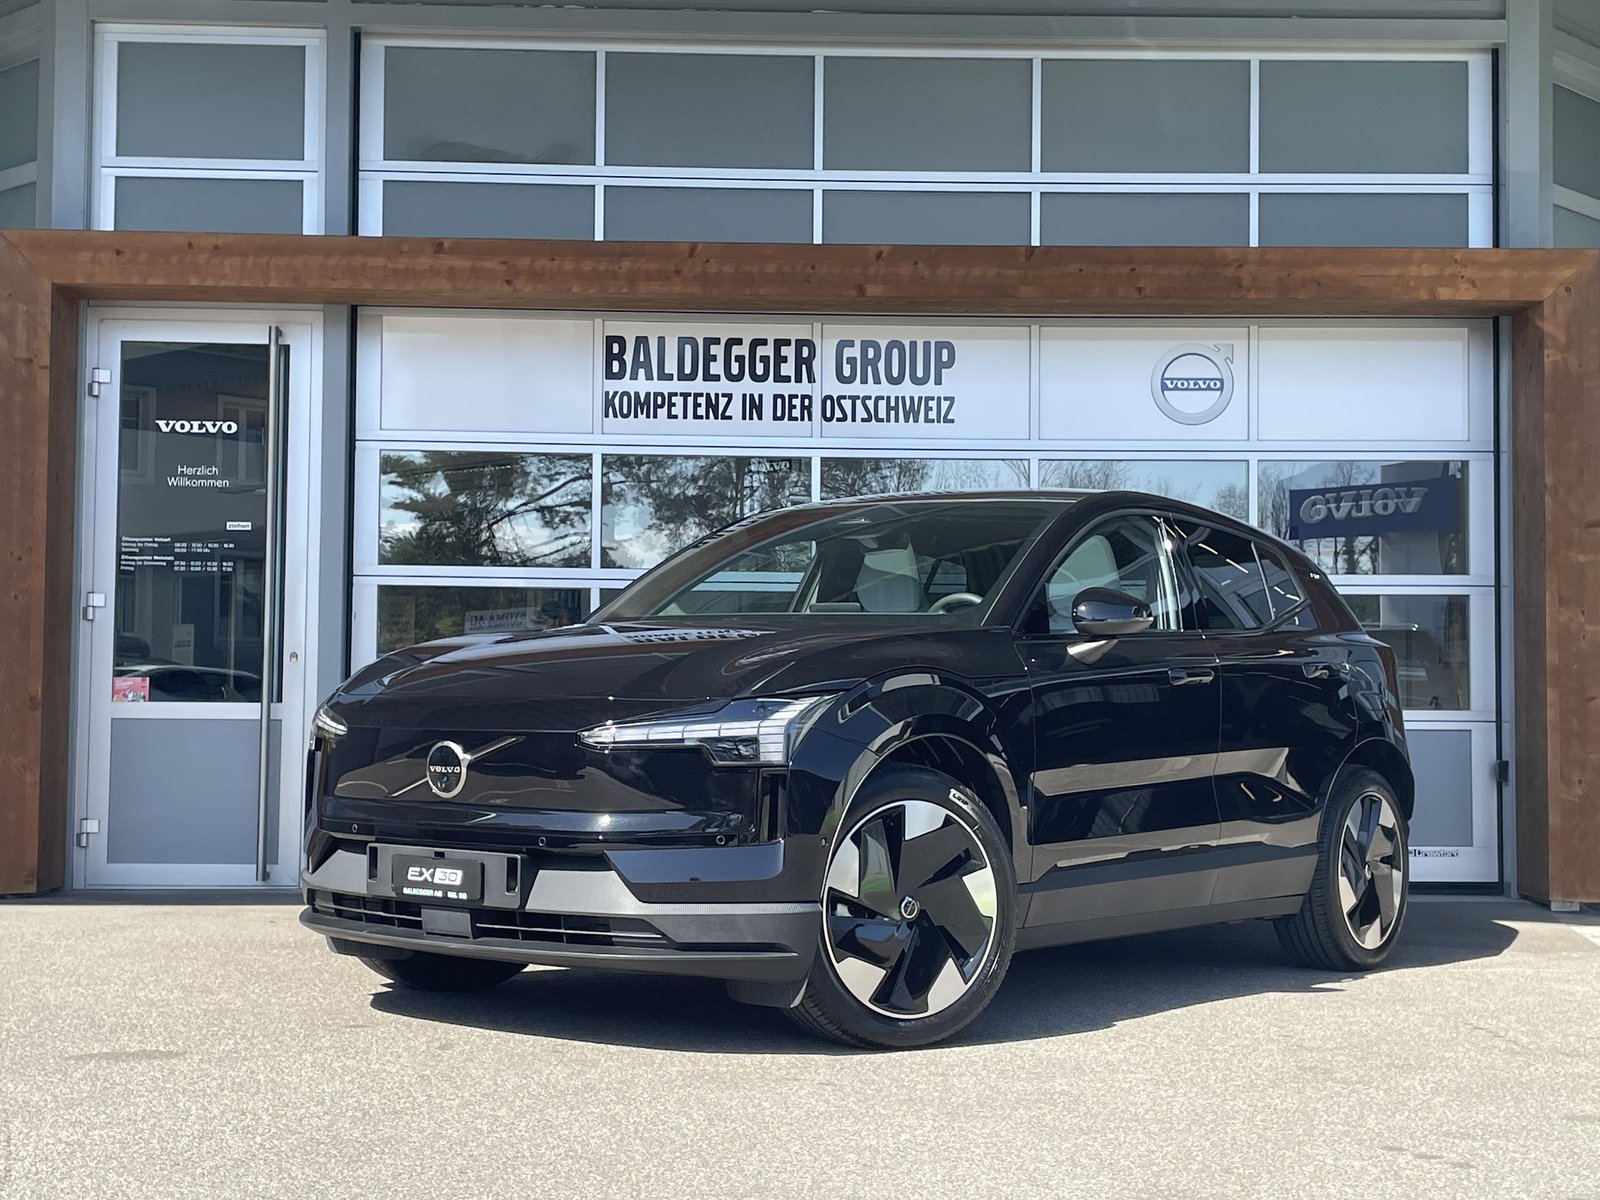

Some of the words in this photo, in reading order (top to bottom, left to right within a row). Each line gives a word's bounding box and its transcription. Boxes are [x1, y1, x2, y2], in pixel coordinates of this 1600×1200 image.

[604, 335, 816, 384] BALDEGGER
[835, 339, 956, 386] GROUP
[1163, 379, 1222, 390] VOLVO
[604, 390, 733, 421] KOMPETENZ
[741, 393, 763, 421] IN
[772, 393, 813, 423] DER
[821, 394, 956, 424] OSTSCHWEIZ
[155, 420, 238, 434] VOLVO
[177, 464, 219, 476] Herzlich
[167, 476, 230, 488] Willkommen
[429, 765, 461, 773] VOLVO
